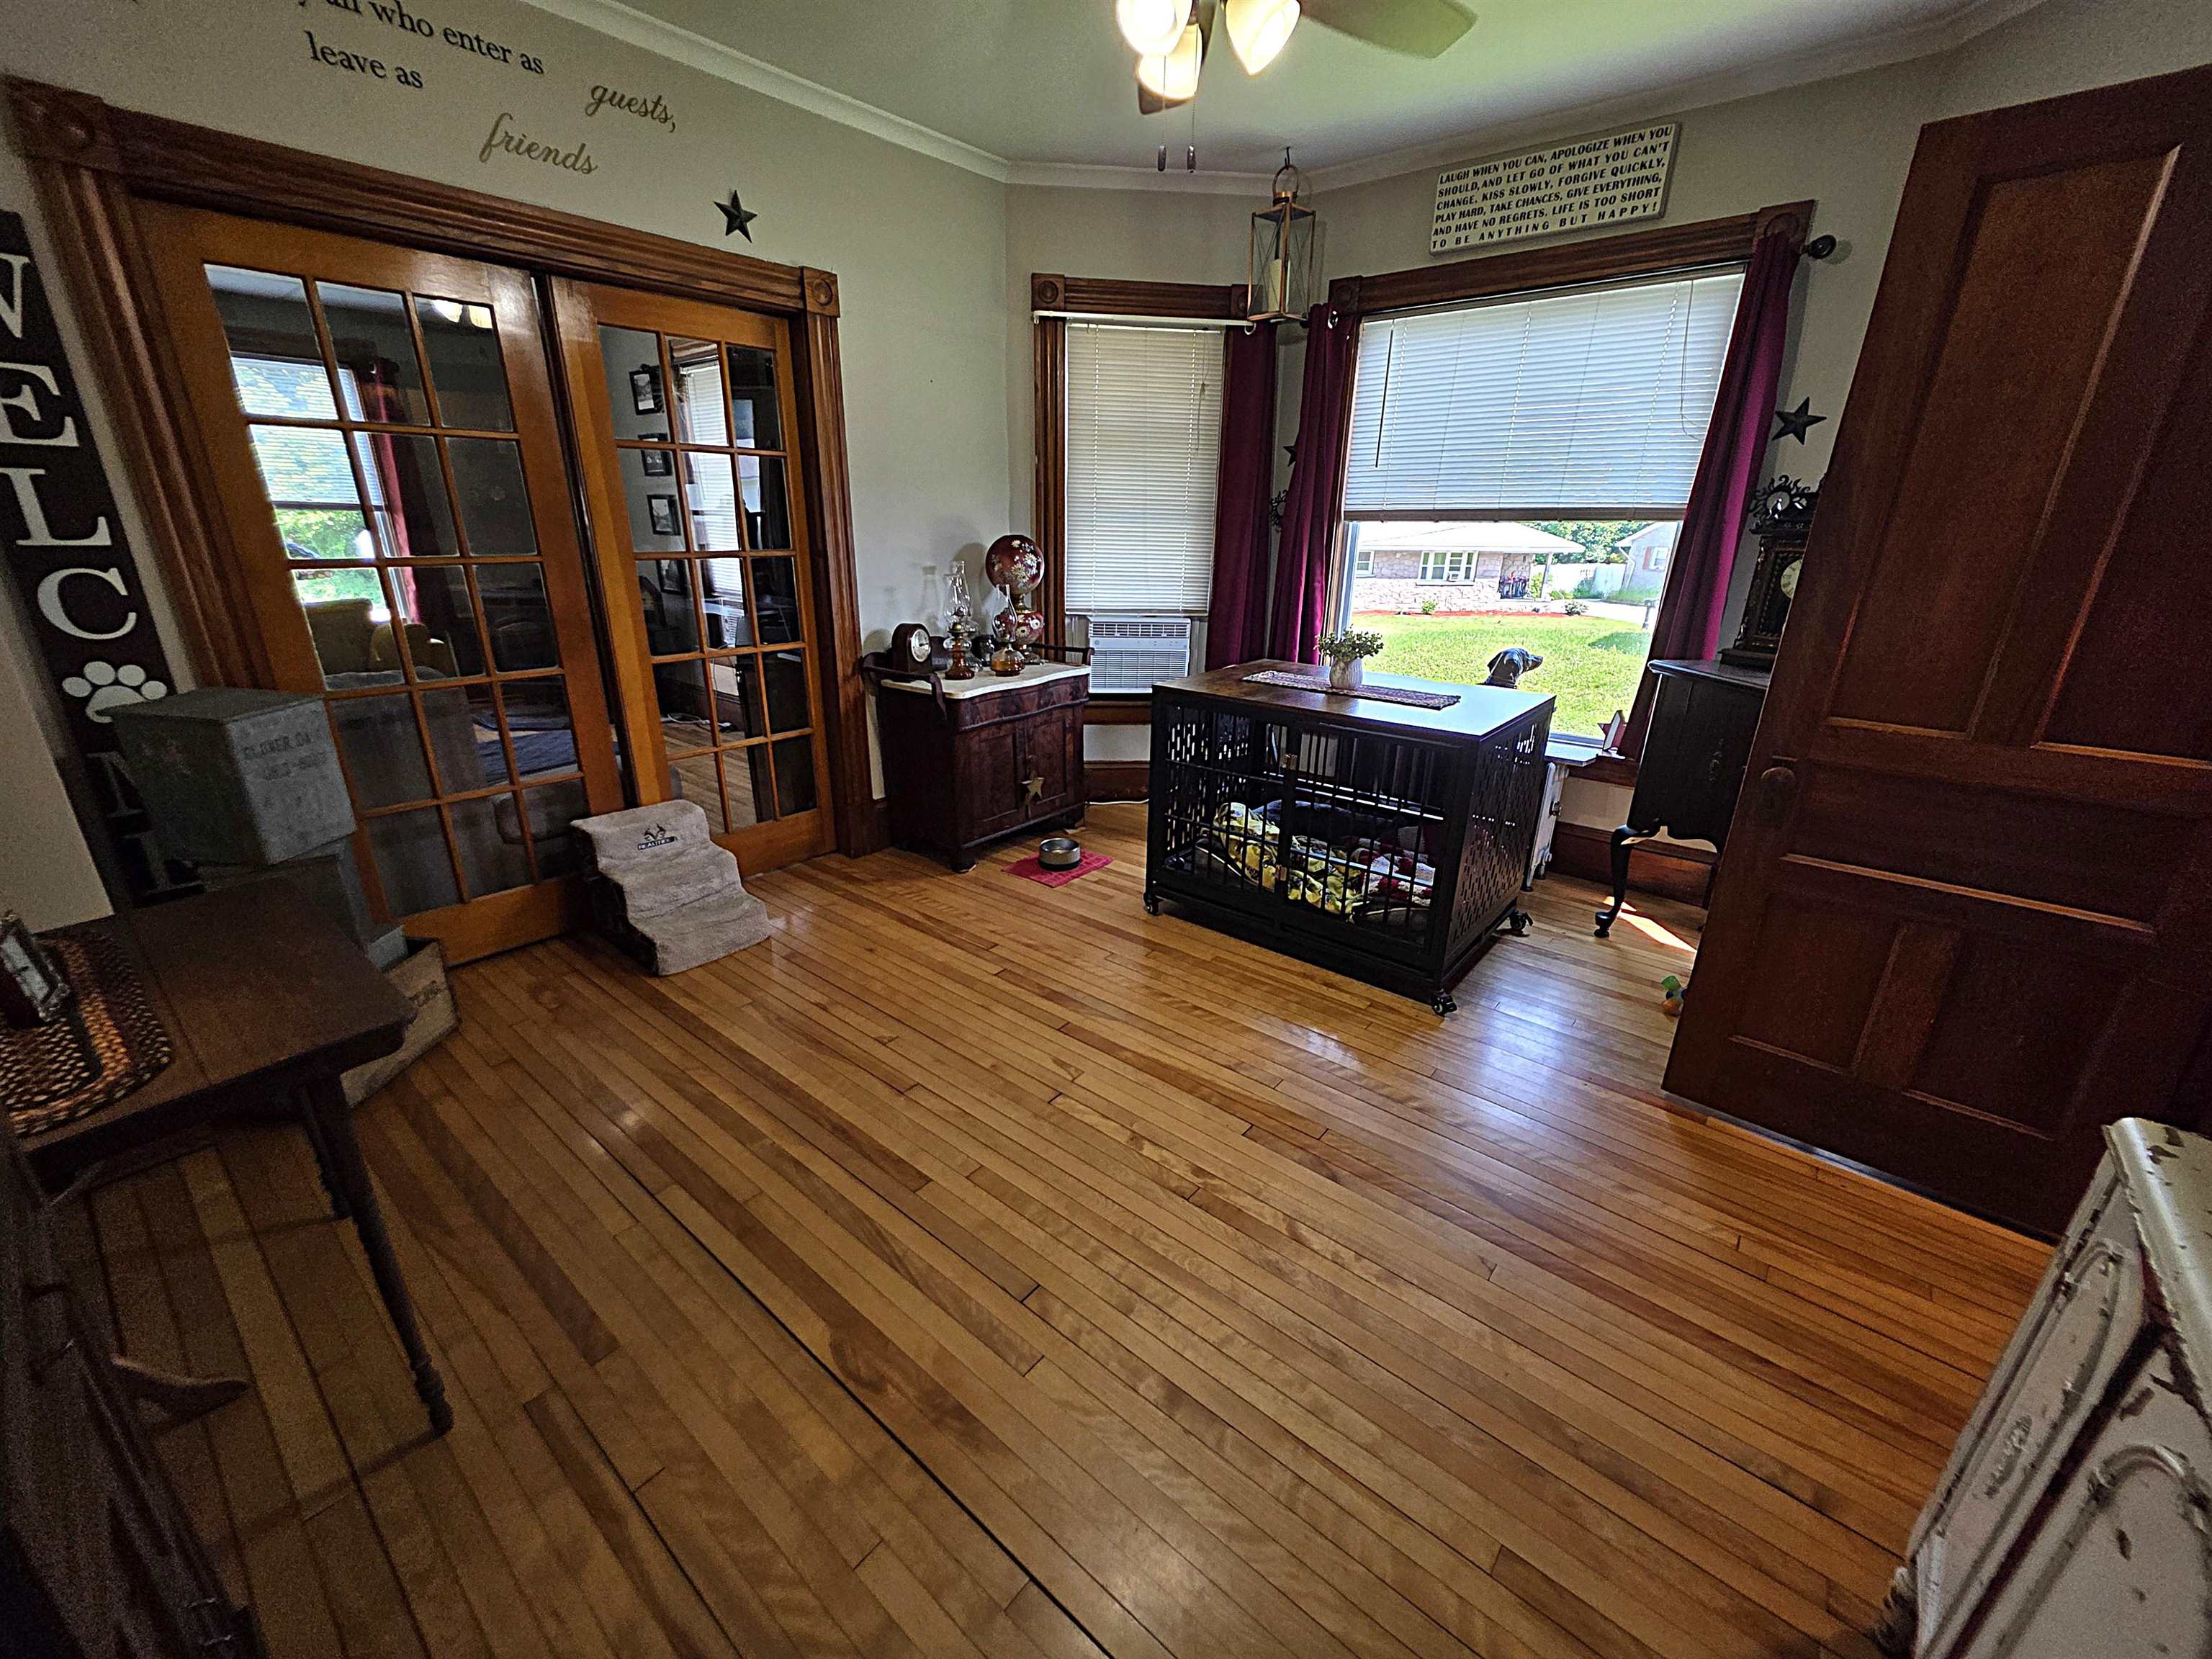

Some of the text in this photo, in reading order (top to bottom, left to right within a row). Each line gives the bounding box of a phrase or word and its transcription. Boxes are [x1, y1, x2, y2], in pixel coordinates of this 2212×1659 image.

[303, 30, 423, 89] leave as
[369, 0, 435, 37] who
[443, 27, 513, 64] enter
[520, 52, 544, 75] as
[585, 84, 676, 133] guests,
[478, 112, 598, 174] friends
[1439, 125, 1672, 185] LAUGH WHEN YOU CAN, APOLOGIZE WHEN YOU
[1506, 171, 1526, 184] LET
[1529, 167, 1545, 179] GO
[1549, 163, 1565, 175] OF
[1568, 155, 1601, 171] WHAT
[1605, 149, 1629, 163] YOU
[1632, 140, 1671, 158] CAN'T
[1435, 171, 1662, 224] PLAY HARD, TAKE CHANCES, GIVE EVERYTHING,
[1437, 157, 1665, 211] CHANGE. KISS SLOWLY, FORGIVE QUICKLY,
[1431, 238, 1447, 249] TO
[1455, 235, 1470, 246] BE
[1478, 220, 1550, 242] ANYTHING
[1559, 213, 1588, 228] BUT
[1432, 186, 1661, 237] AND HAVE NO REGRETS. LIFE IS TOO SHORT
